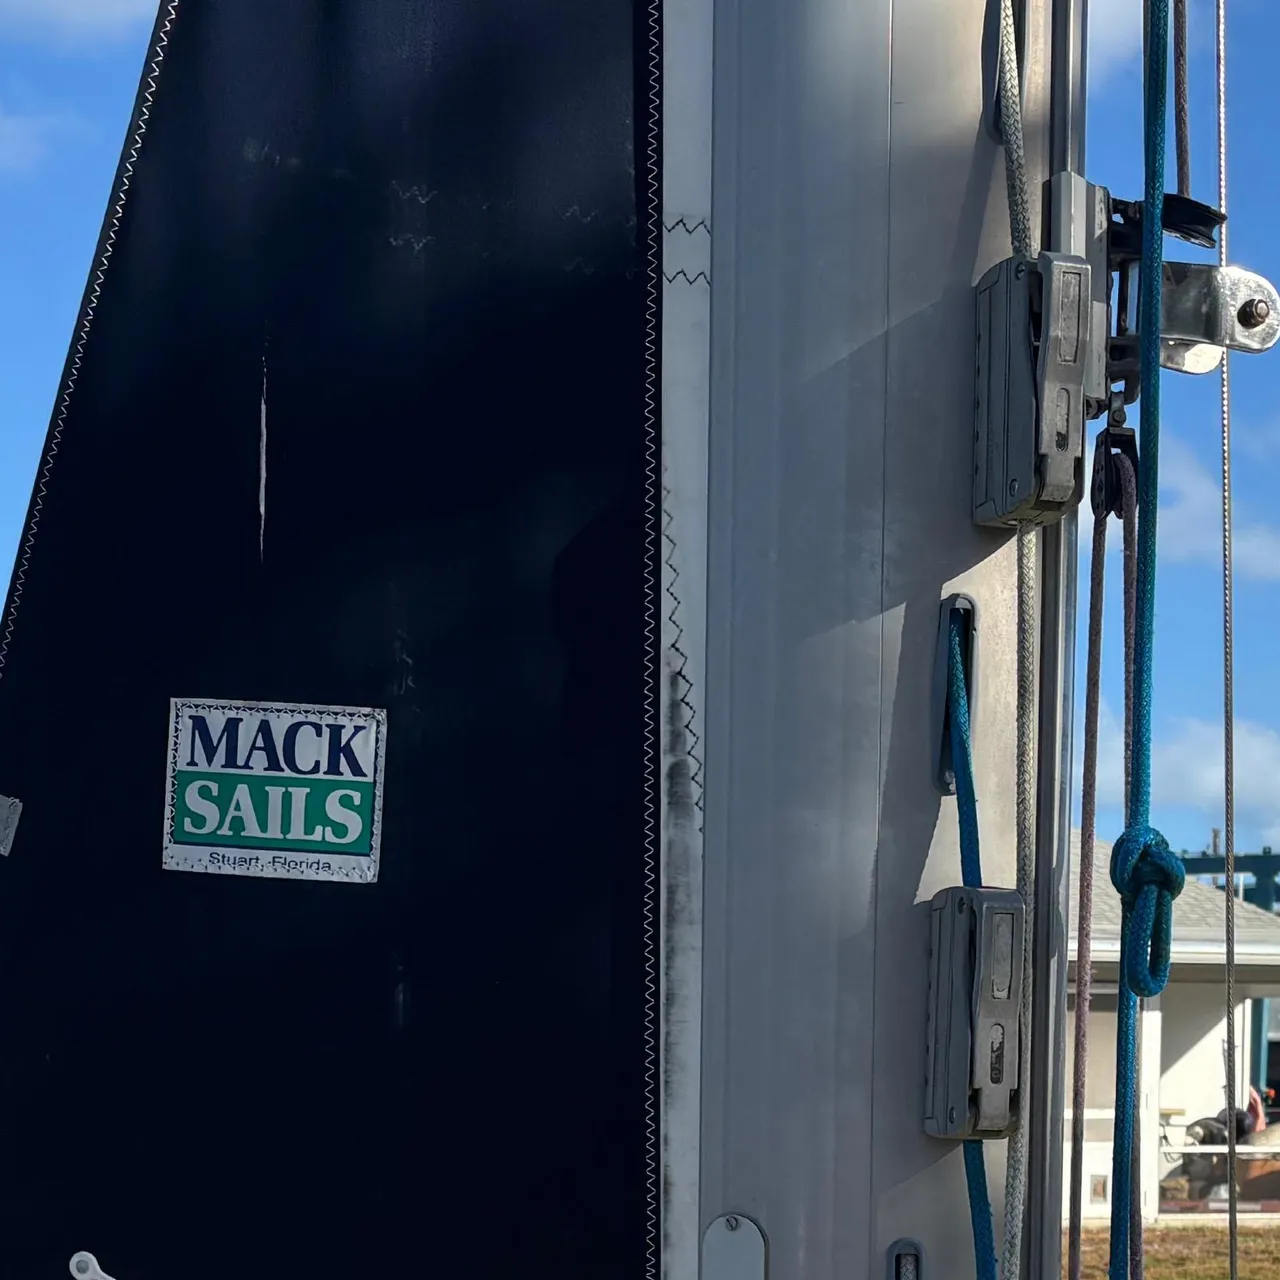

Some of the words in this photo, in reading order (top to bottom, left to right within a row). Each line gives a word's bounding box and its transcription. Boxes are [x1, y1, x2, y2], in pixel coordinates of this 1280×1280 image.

[186, 715, 368, 777] MACK
[183, 780, 363, 844] SAILS
[272, 856, 332, 873] Florida
